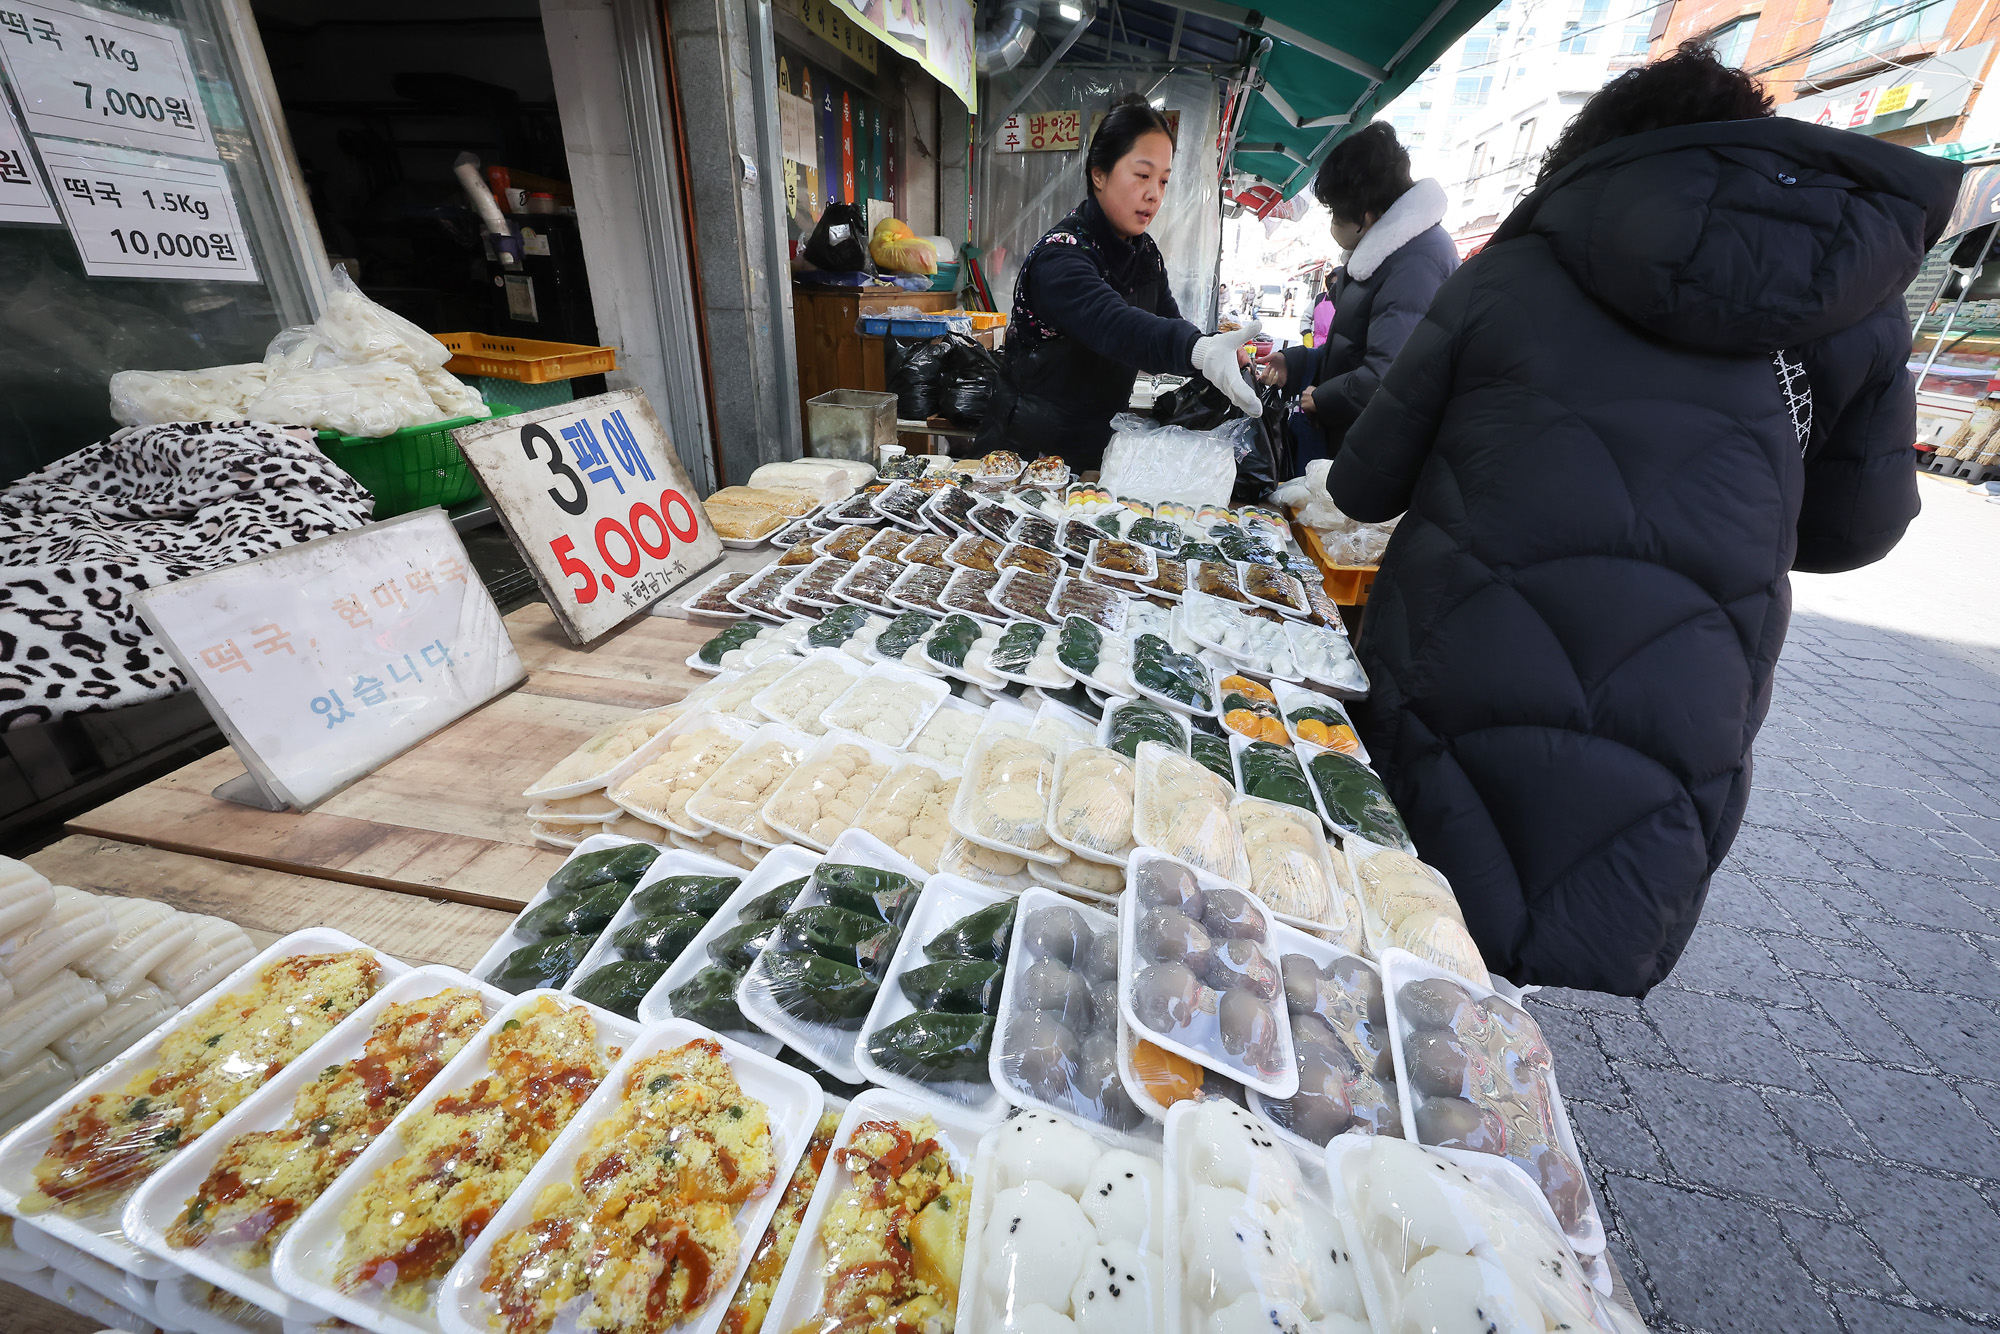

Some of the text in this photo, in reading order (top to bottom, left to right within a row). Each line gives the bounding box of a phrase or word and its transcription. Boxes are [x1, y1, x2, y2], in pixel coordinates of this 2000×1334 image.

[0, 10, 139, 71] 떡국 1Kg
[73, 80, 196, 130] 7,000원
[63, 177, 209, 220] 떡국 1.5Kg
[110, 228, 237, 261] 10,000원
[521, 409, 656, 516] 3팩에
[549, 488, 699, 604] 5,000
[199, 556, 468, 674] 떡국, 현미떡국
[309, 639, 471, 730] 있습니다.
